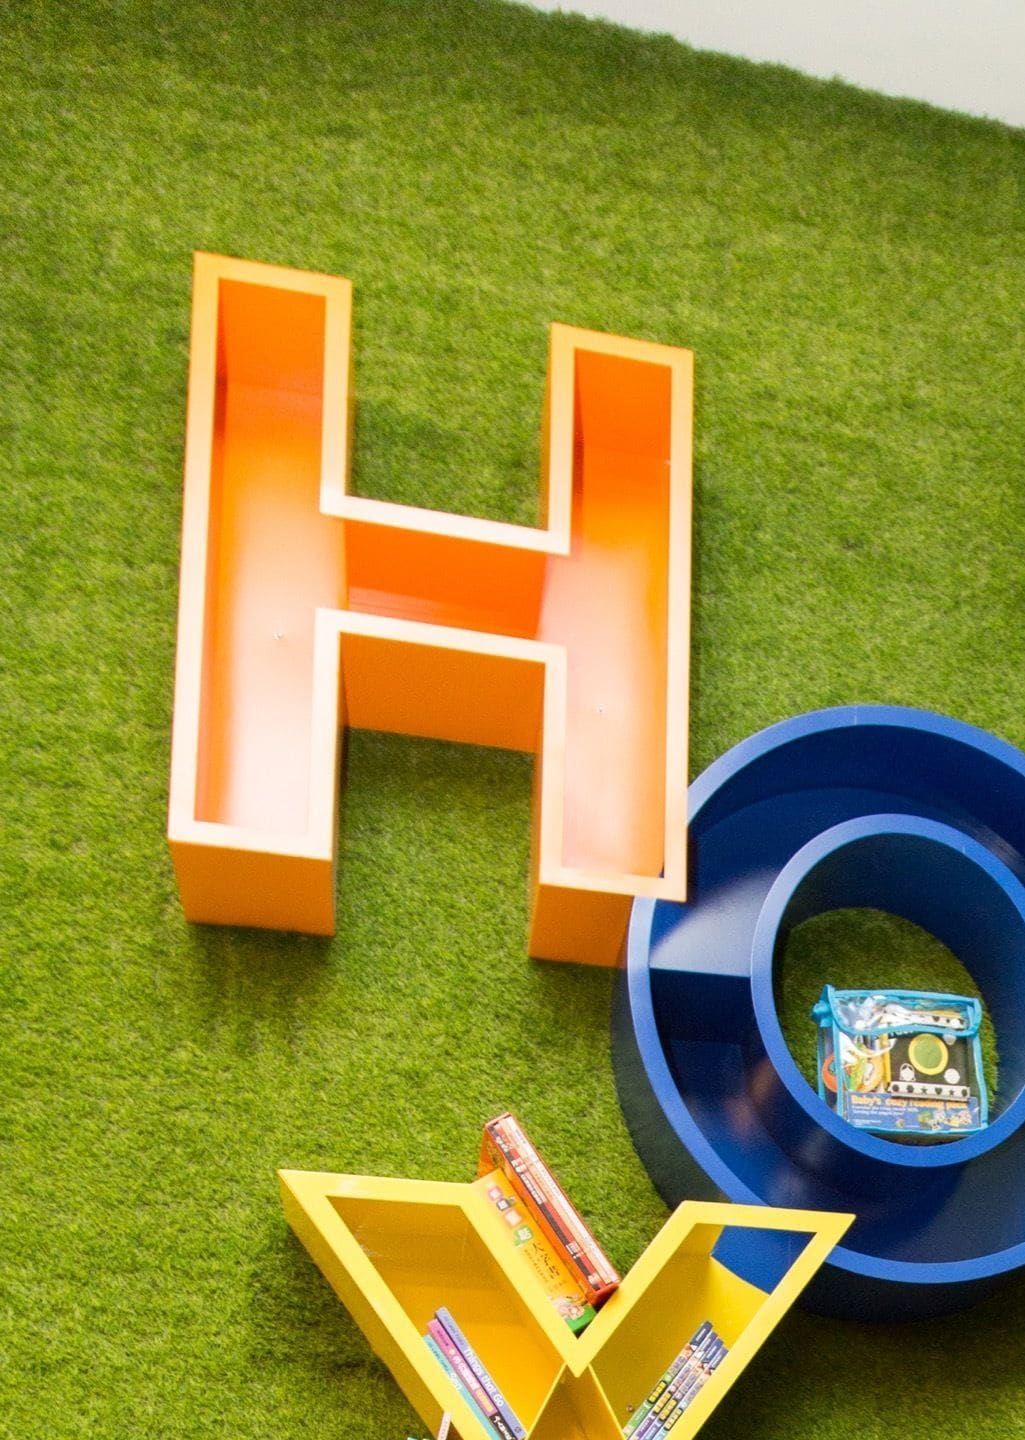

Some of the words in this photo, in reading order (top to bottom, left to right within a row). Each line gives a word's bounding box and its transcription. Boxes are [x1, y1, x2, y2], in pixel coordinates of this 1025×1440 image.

[464, 1347, 485, 1378] Things
[480, 1373, 498, 1397] that
[493, 1393, 505, 1407] Go
